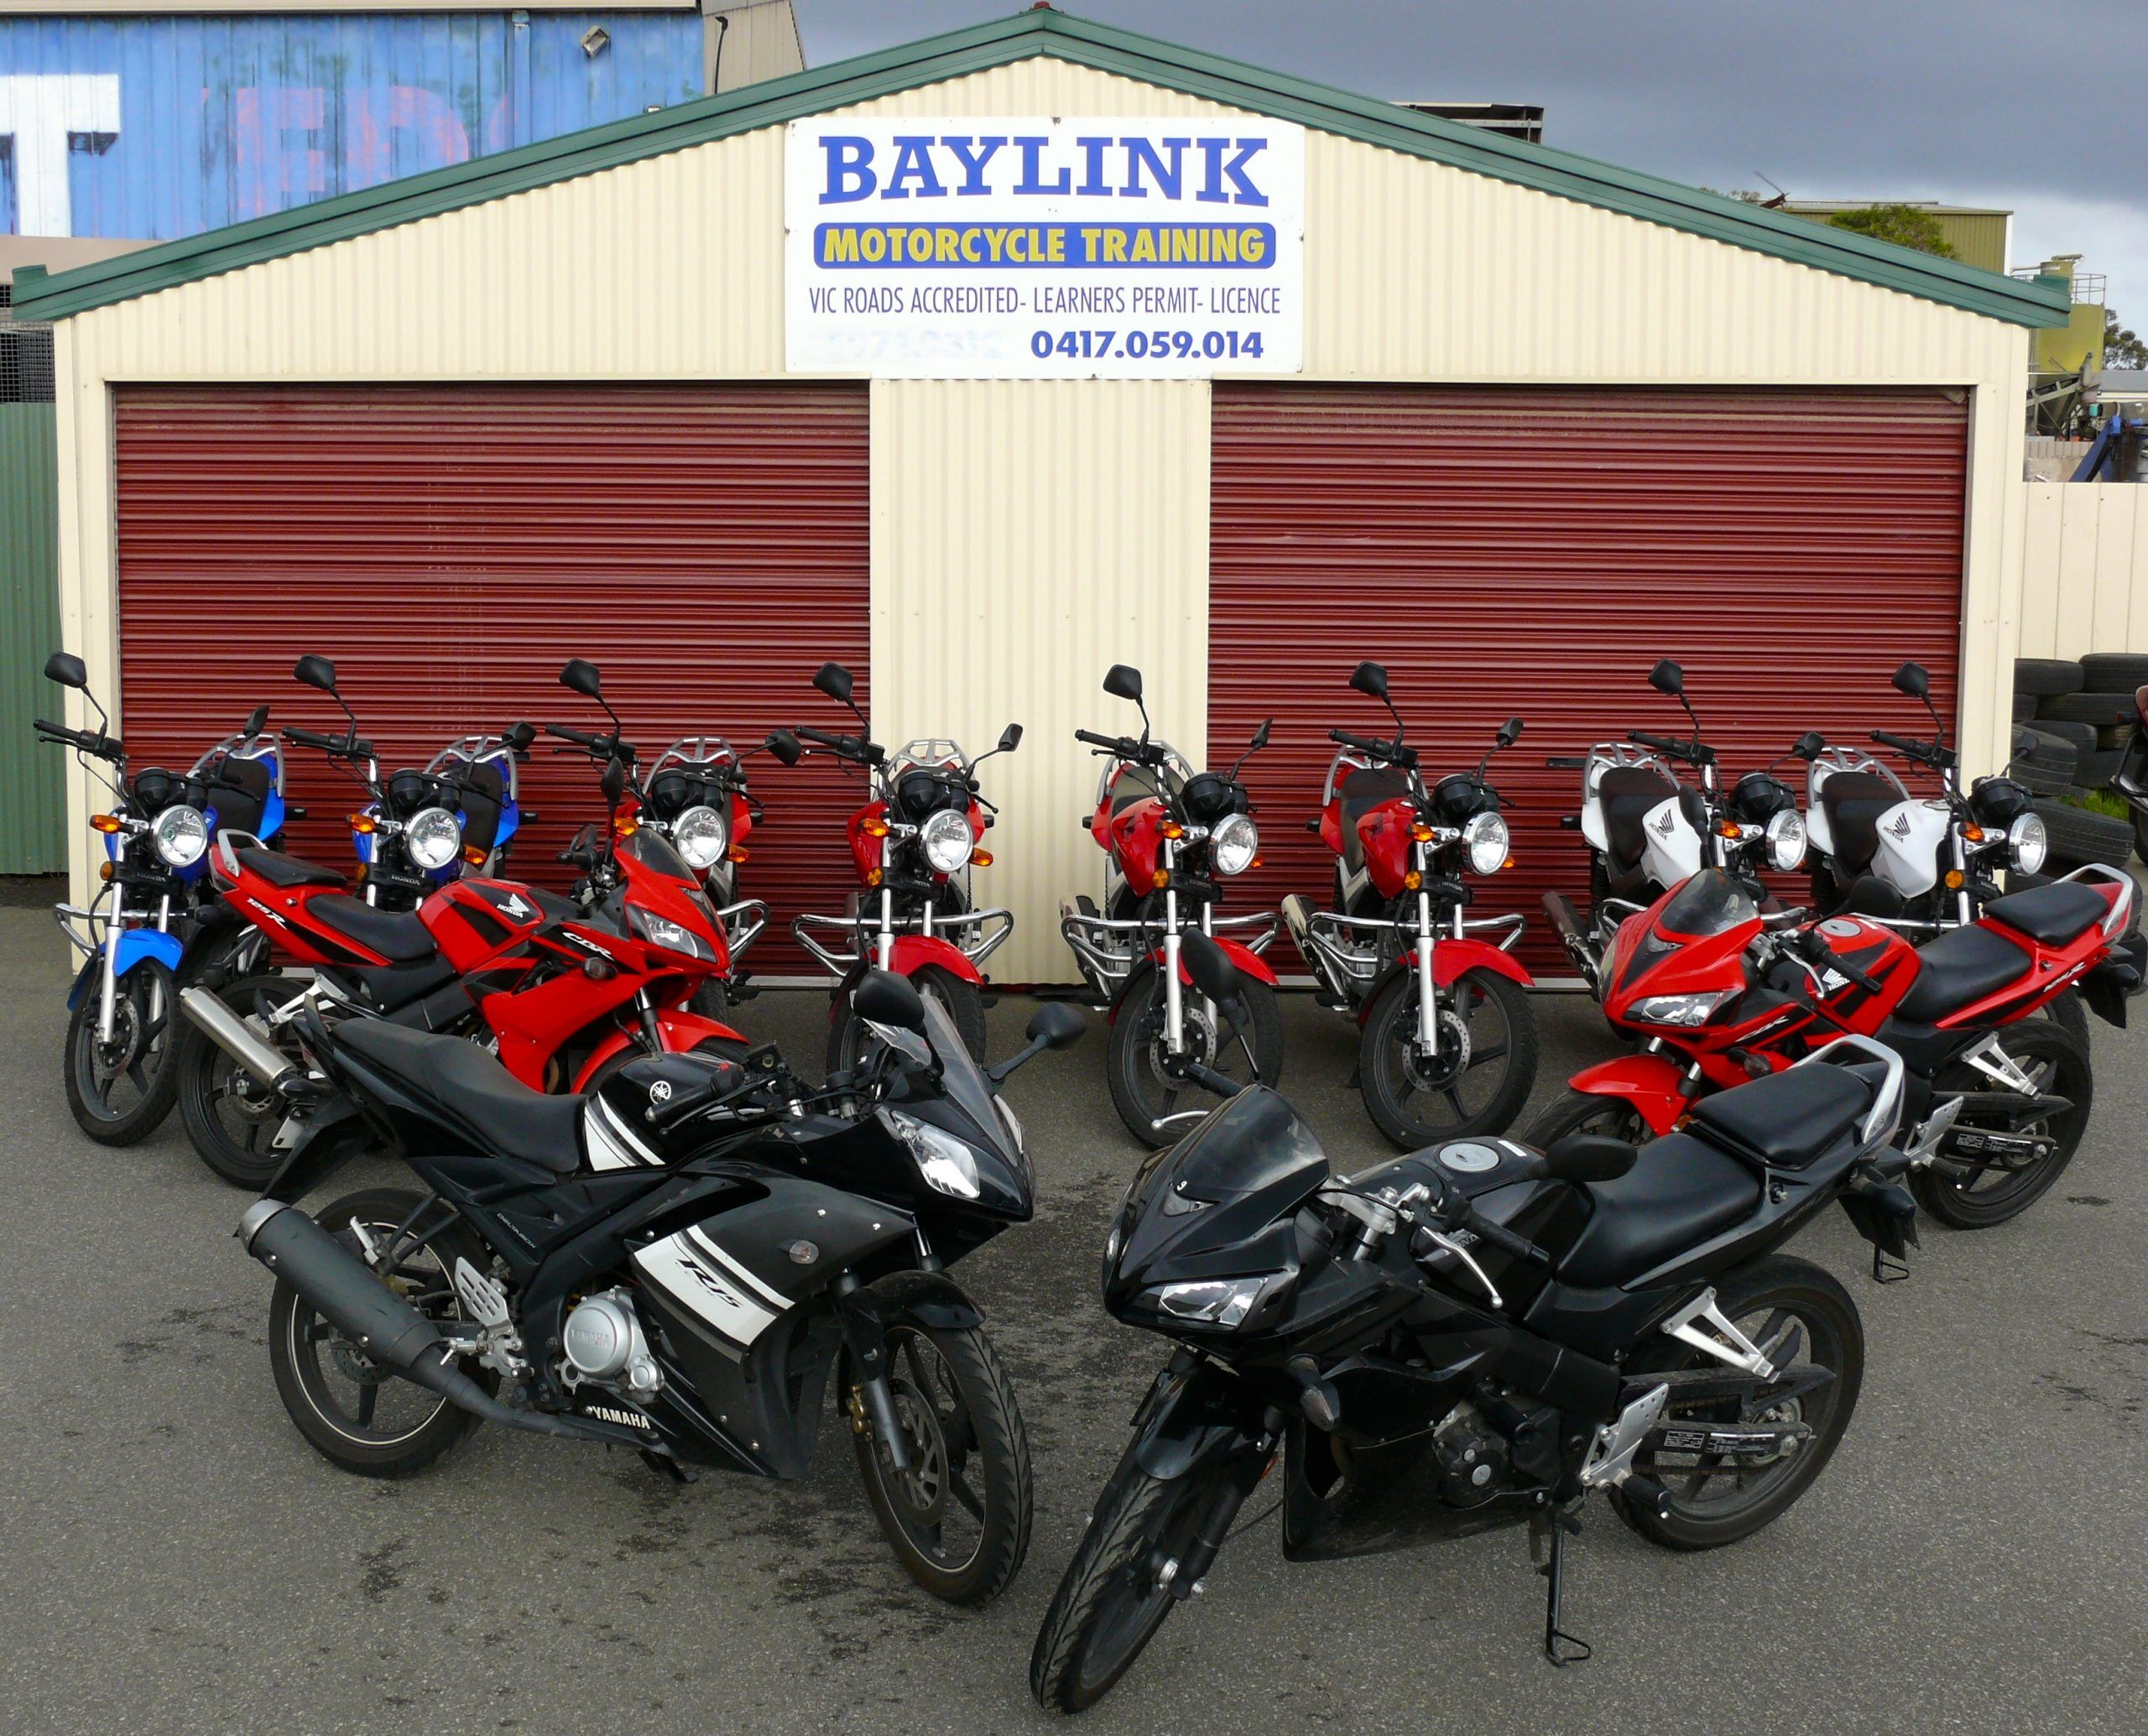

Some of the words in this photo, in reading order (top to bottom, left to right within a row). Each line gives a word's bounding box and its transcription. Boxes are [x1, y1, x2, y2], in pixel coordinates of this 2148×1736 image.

[819, 135, 1269, 206] BAYLINK
[823, 227, 1066, 263] MOTORCYCLE
[1081, 227, 1264, 263] TRAINING
[809, 287, 837, 314] VIC
[843, 287, 904, 314] ROADS
[910, 286, 1026, 314] ACCREDITED-
[1033, 286, 1125, 314] LEARNERS
[1133, 286, 1203, 314] PERMIT-
[1211, 286, 1280, 314] LICENCE
[1031, 330, 1264, 358] 0417.059.014
[1648, 821, 1668, 841] HONDA
[1882, 826, 1904, 843] HONDA
[391, 874, 420, 886] HONDA
[496, 904, 524, 919] HONDA
[562, 931, 615, 962] CBR
[592, 1405, 651, 1430] YAMAHA
